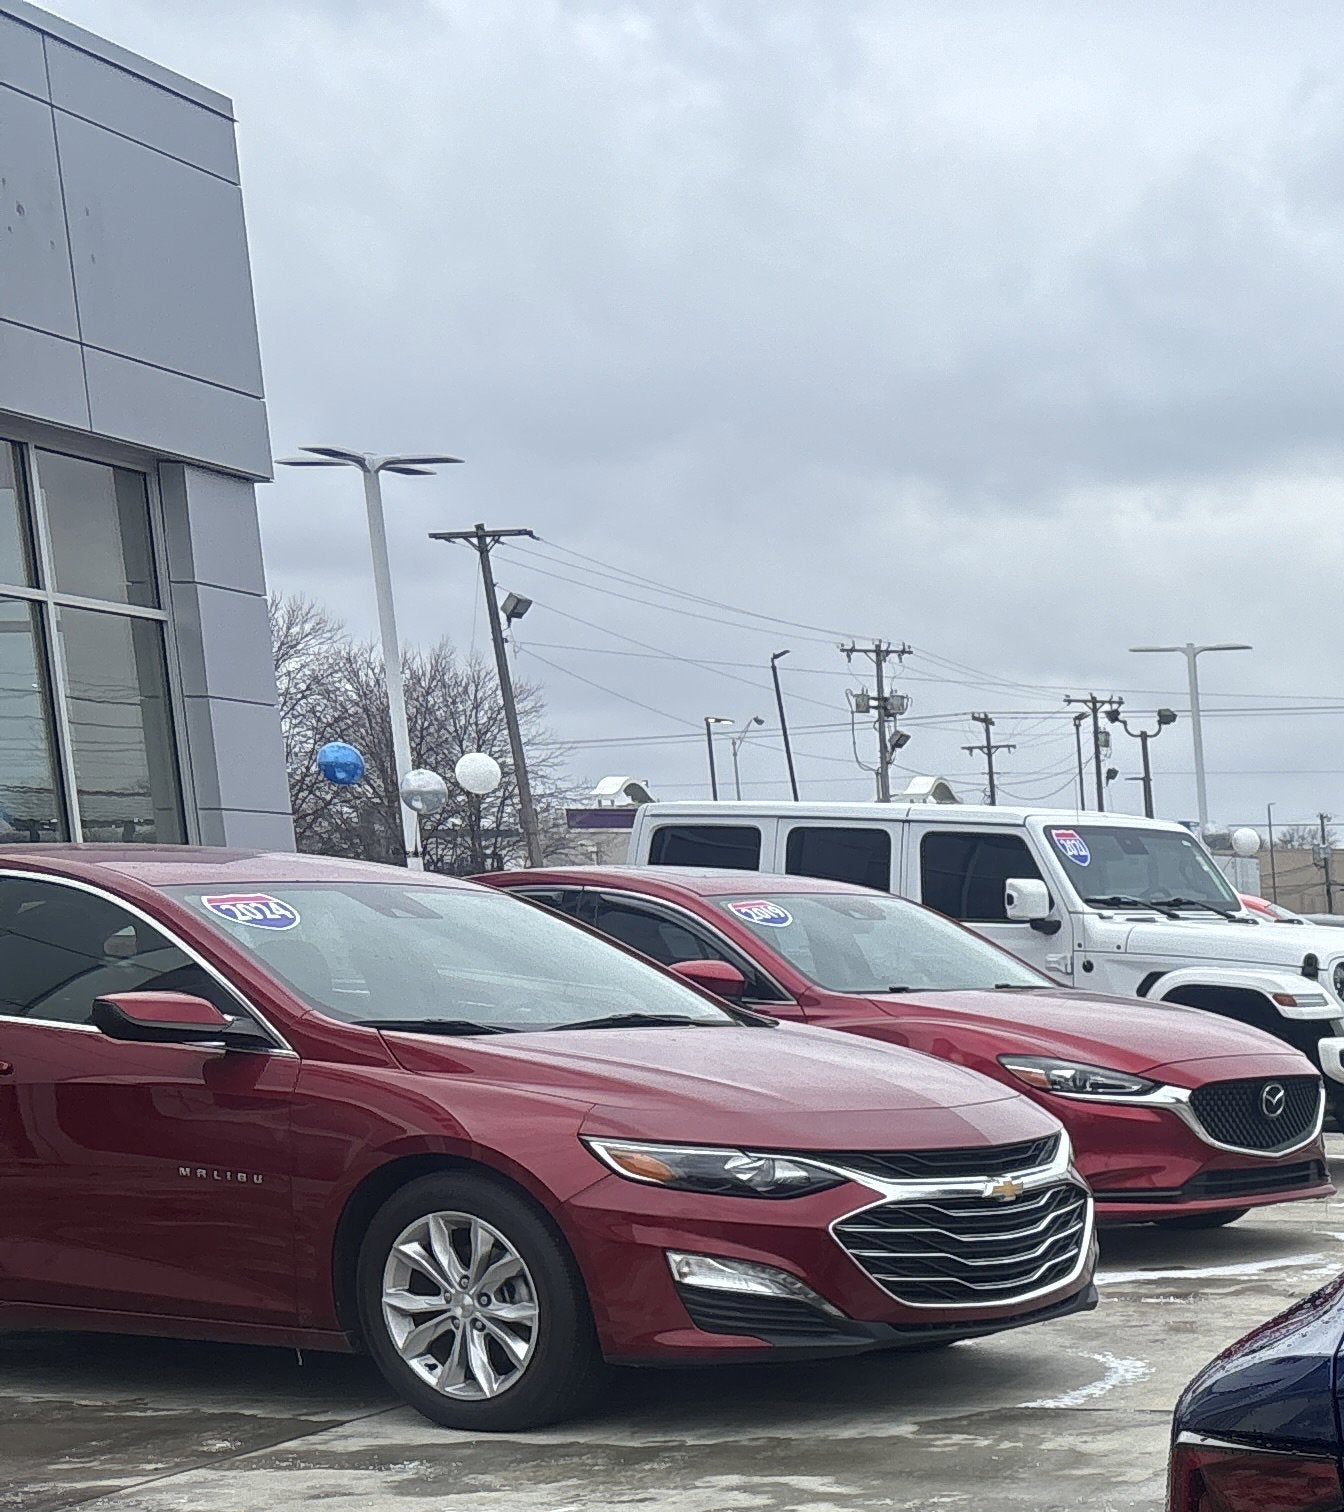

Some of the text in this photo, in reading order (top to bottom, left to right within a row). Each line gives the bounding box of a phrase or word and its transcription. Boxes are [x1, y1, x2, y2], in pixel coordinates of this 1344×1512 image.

[220, 902, 294, 921] 2024
[741, 905, 786, 920] 2019
[179, 1167, 263, 1184] MALIBU
